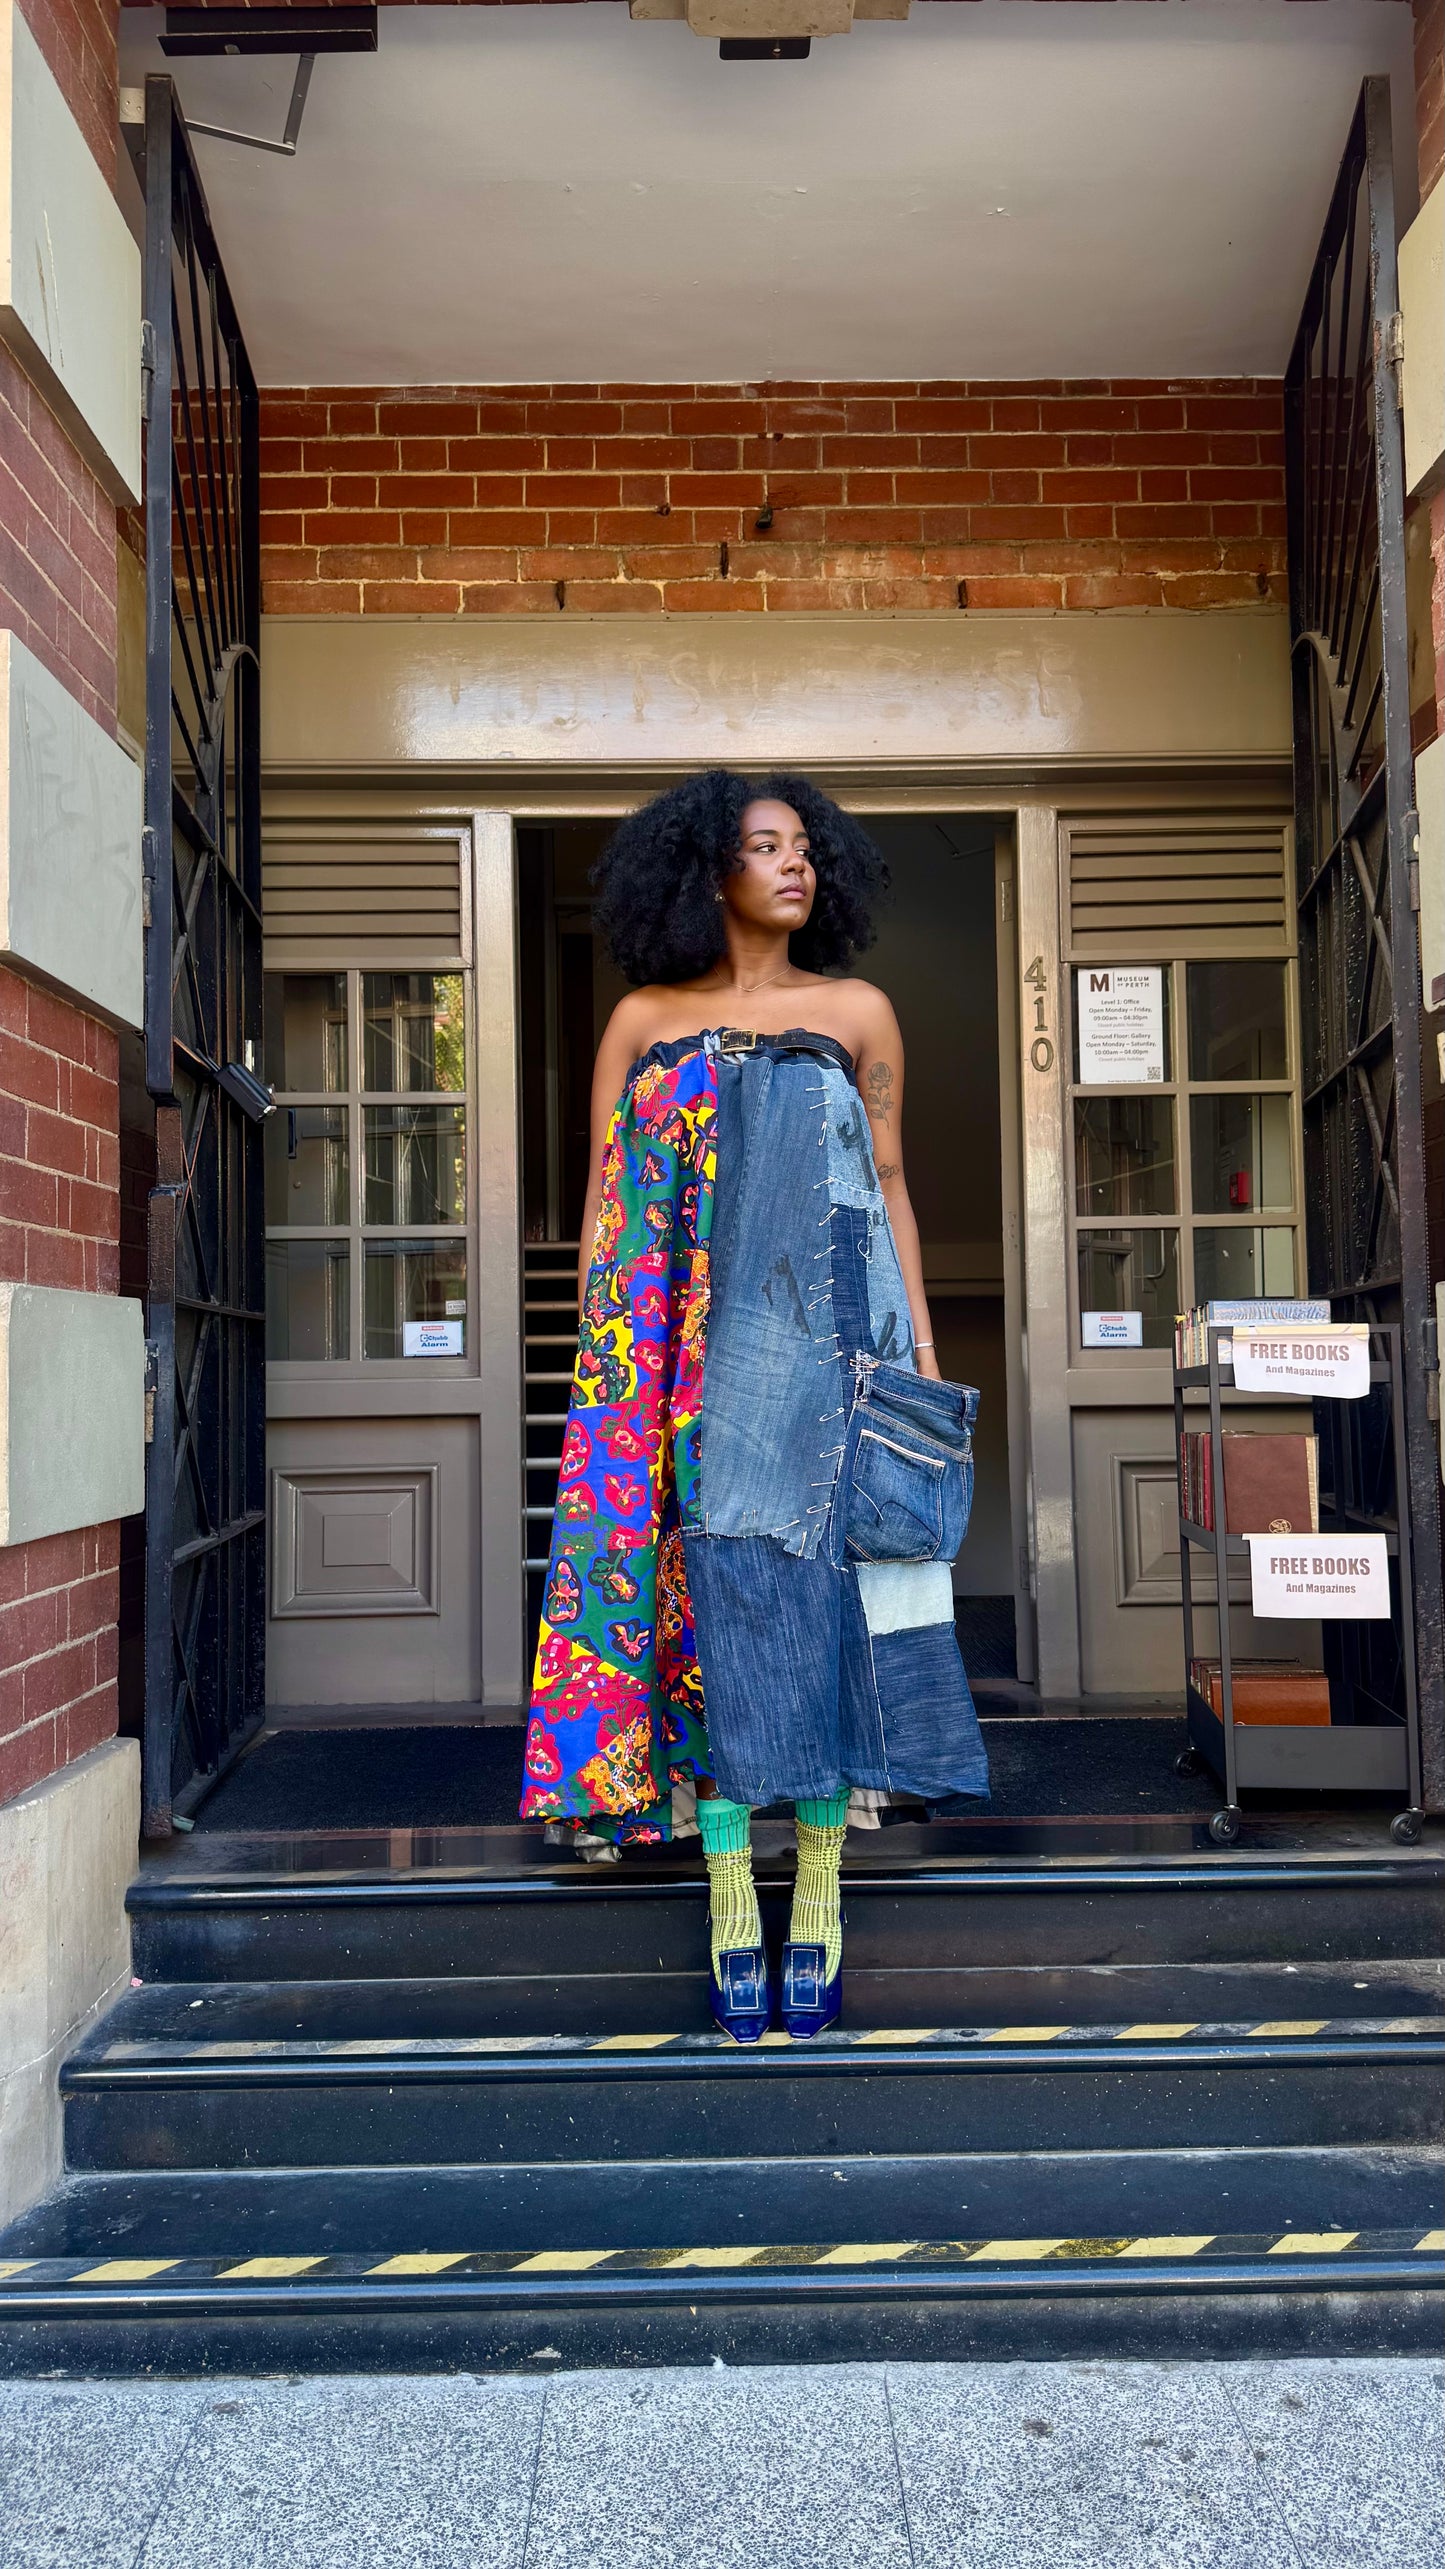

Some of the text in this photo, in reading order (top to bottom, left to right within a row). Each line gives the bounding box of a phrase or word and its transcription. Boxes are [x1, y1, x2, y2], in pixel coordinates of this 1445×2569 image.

[1090, 974, 1110, 992] M
[1024, 956, 1054, 1072] 410
[1250, 1343, 1350, 1362] FREE BOOKS
[1266, 1365, 1336, 1377] And Magazines
[1270, 1557, 1370, 1576] FREE BOOKS
[1286, 1583, 1356, 1595] And Magazines
